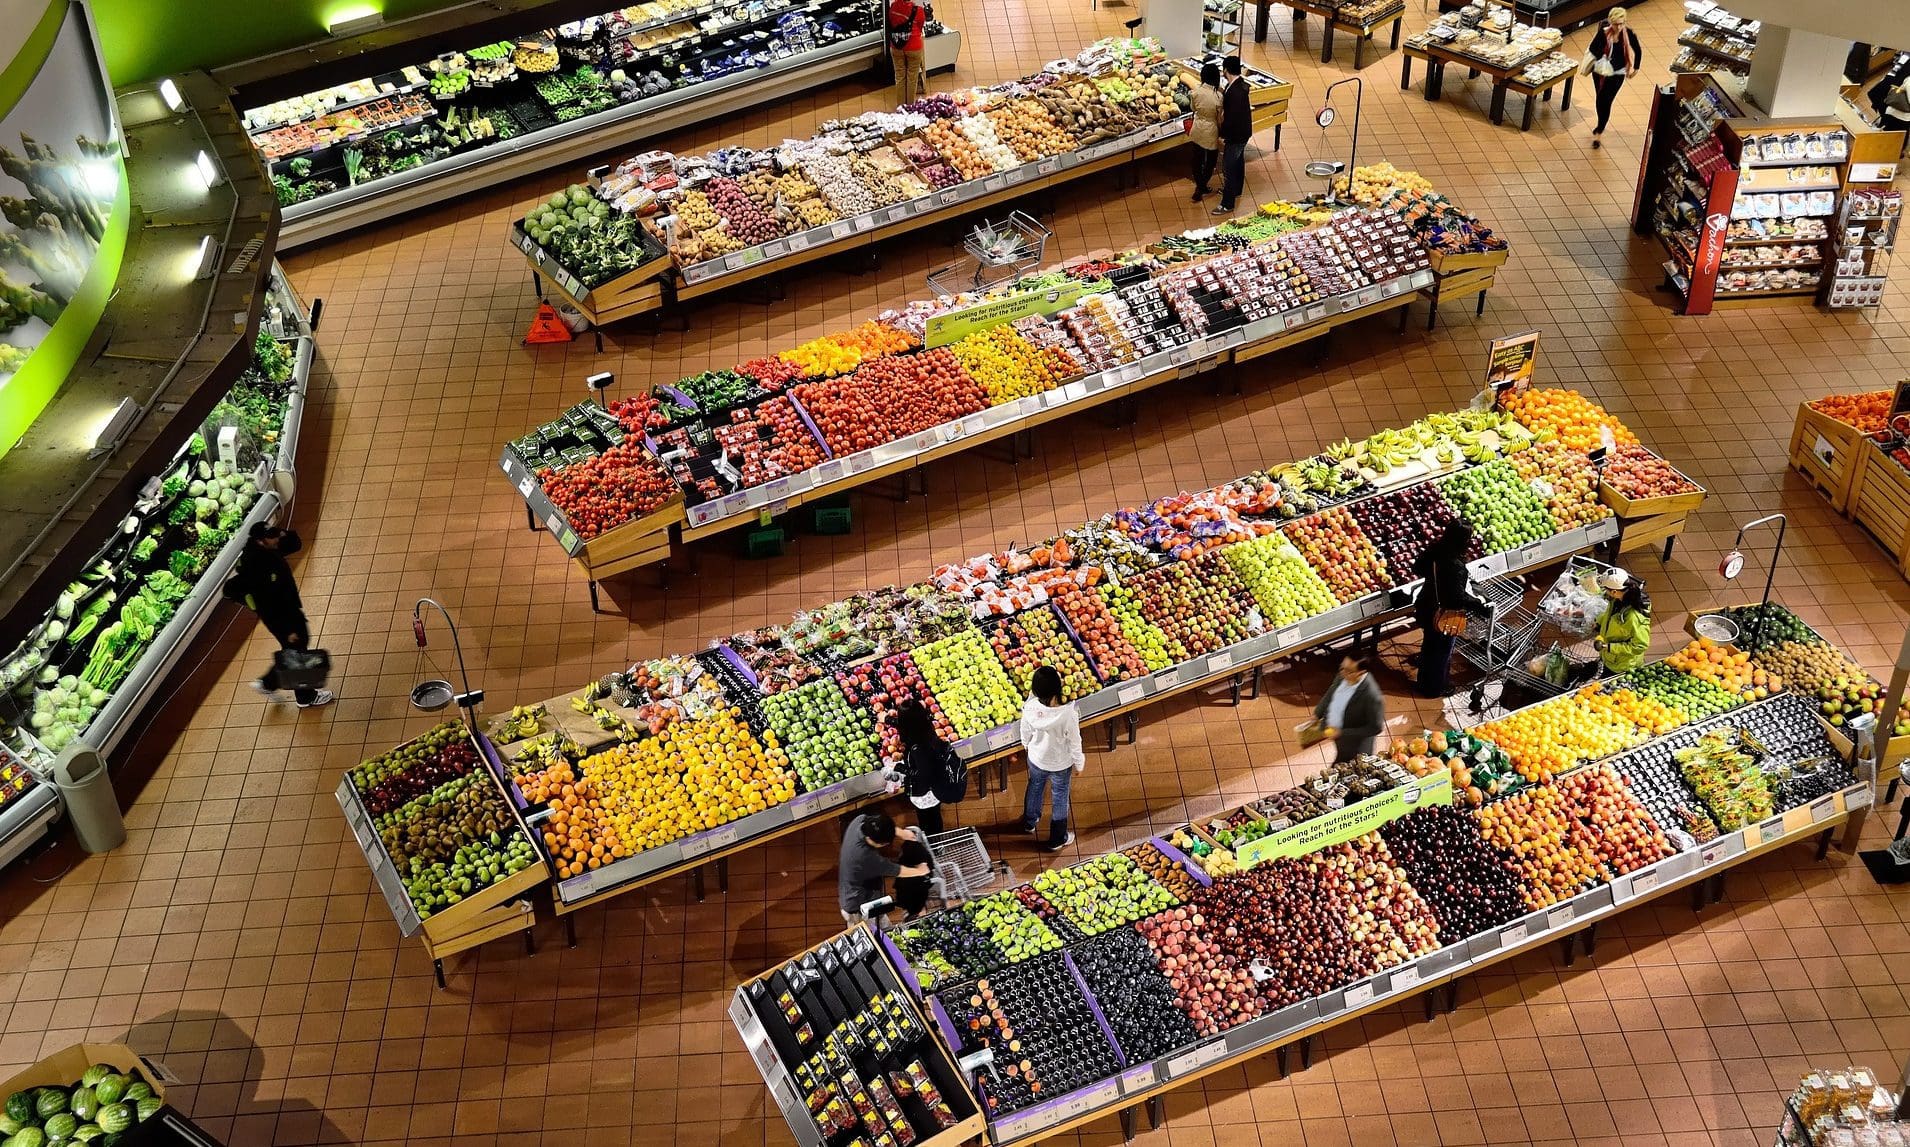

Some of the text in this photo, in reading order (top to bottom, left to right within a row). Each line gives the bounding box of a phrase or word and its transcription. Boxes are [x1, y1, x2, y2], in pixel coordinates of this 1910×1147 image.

[1705, 213, 1728, 275] Vachon
[954, 294, 1044, 321] Looking for nutritious choices?
[1010, 304, 1028, 313] Stars!
[1277, 829, 1308, 845] Looking
[1310, 823, 1322, 833] for
[1324, 810, 1363, 828] nutritious
[1365, 794, 1399, 812] choices?
[1299, 810, 1379, 845] Reach for the Stars!
